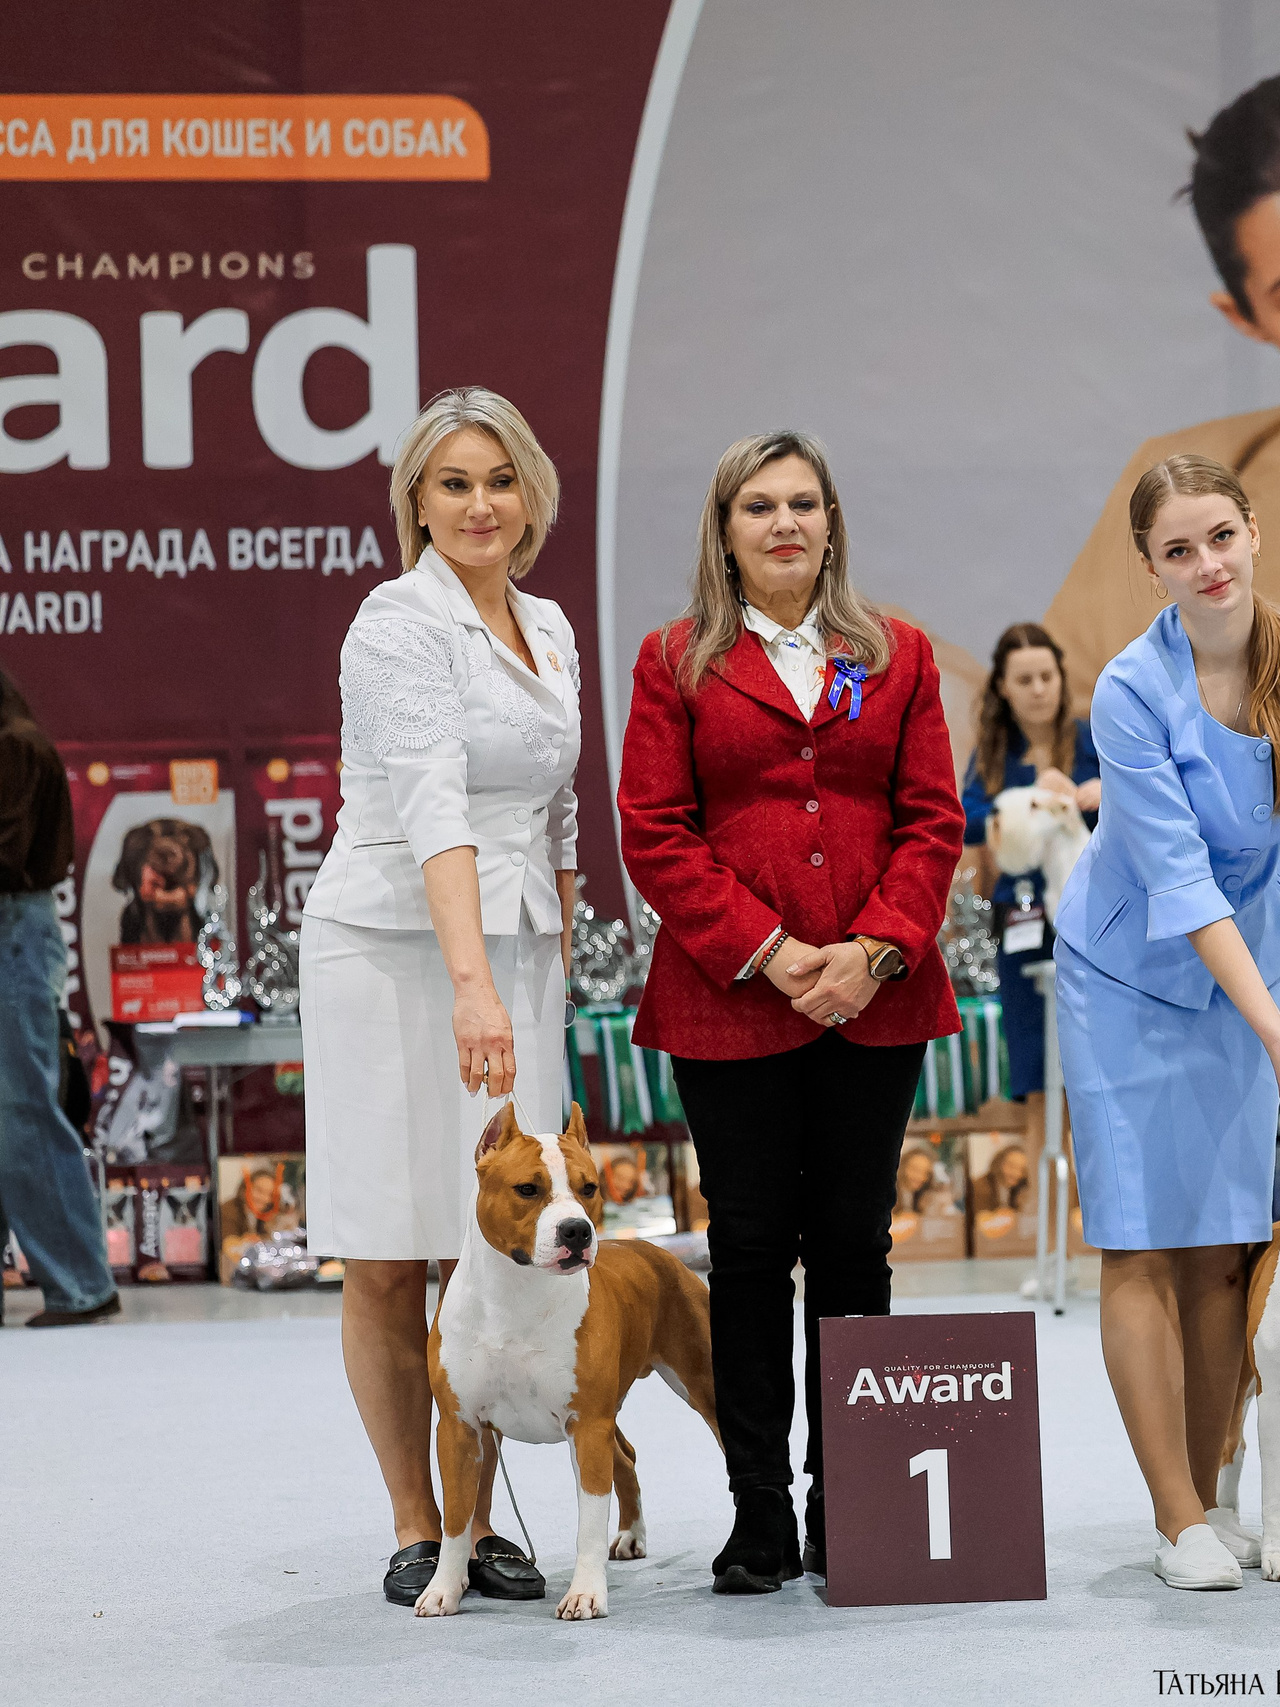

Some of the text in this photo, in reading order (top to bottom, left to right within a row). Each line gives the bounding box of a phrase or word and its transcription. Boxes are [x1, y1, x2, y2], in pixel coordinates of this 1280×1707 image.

[0, 118, 467, 164] СА ДЛЯ КОШЕК И СОБАК
[22, 251, 316, 280] CHAMPIONS
[24, 528, 217, 579] НАГРАДА
[228, 526, 385, 576] ВСЕГДА
[265, 798, 323, 925] ard
[847, 1361, 1012, 1405] Award
[944, 1363, 995, 1371] CHAMPIONS
[909, 1448, 951, 1560] 1
